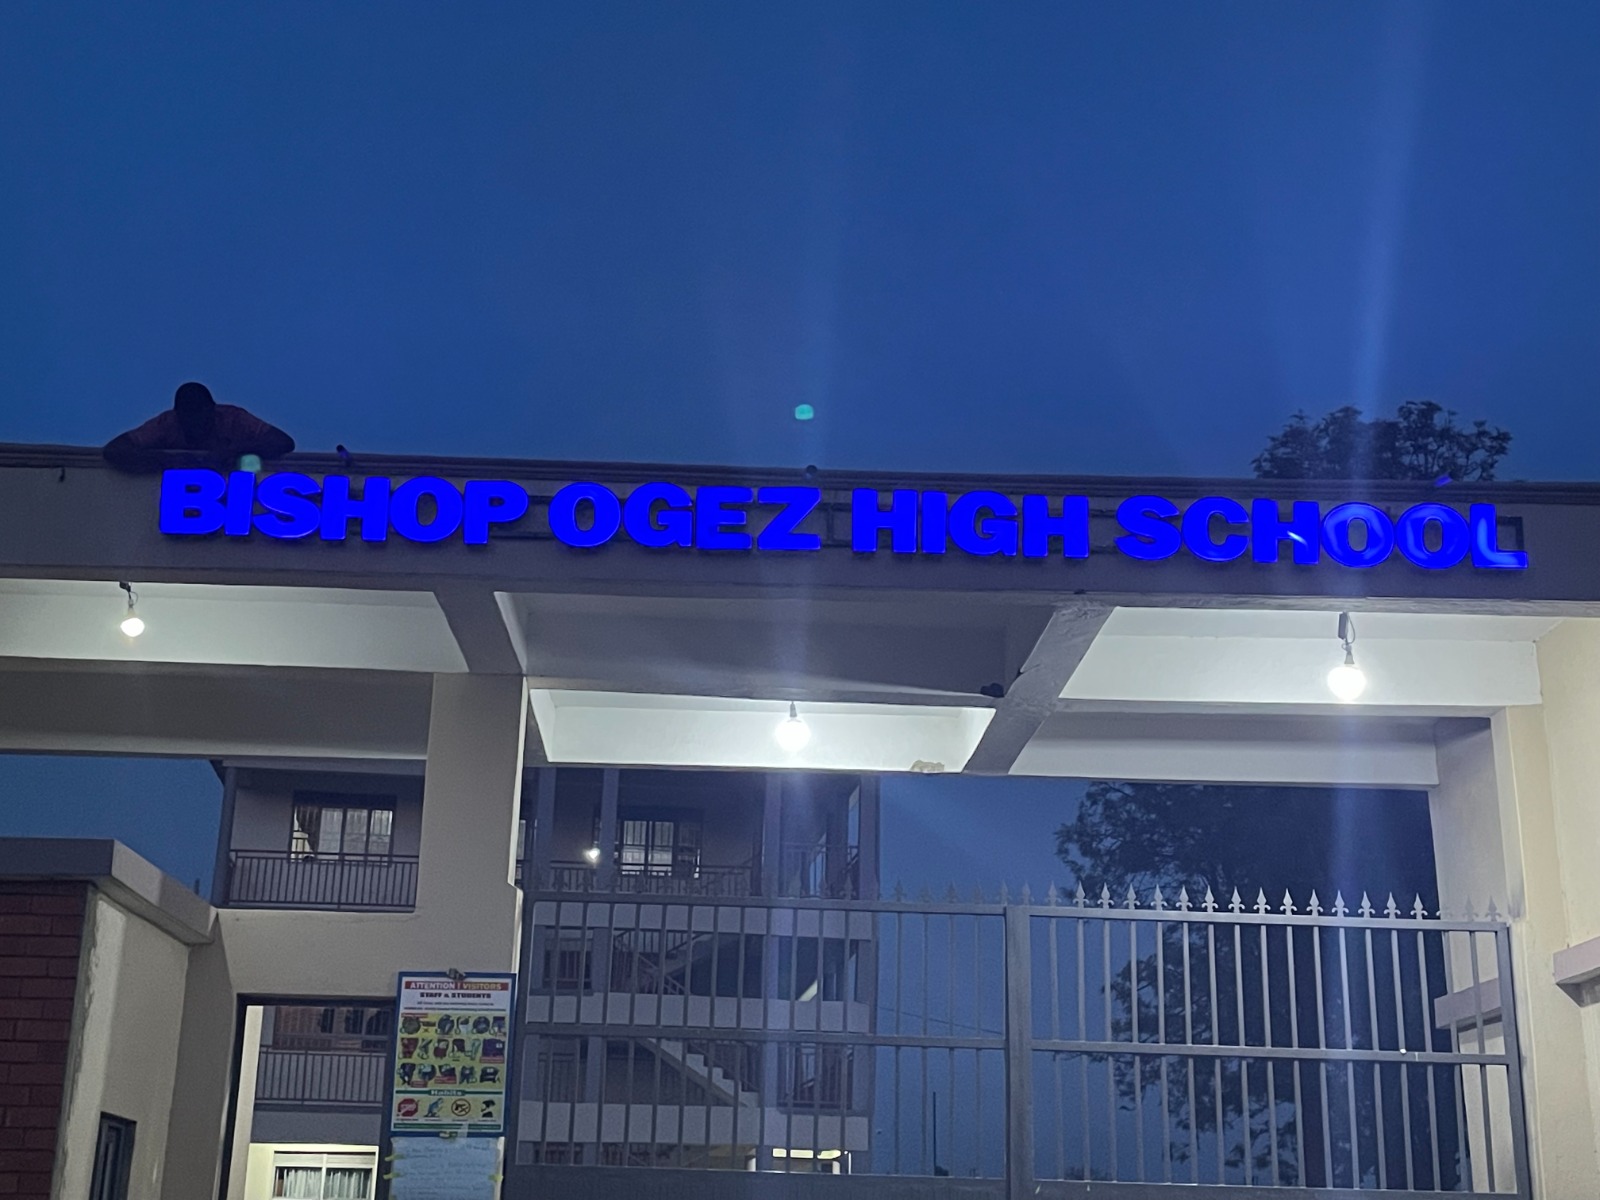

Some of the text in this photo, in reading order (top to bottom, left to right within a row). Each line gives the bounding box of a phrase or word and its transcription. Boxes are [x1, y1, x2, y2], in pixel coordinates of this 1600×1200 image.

[159, 468, 1530, 570] BISHOP OGEZ HIGH SCHOOL
[410, 982, 455, 990] ATTENTION
[463, 982, 502, 991] VISITORS
